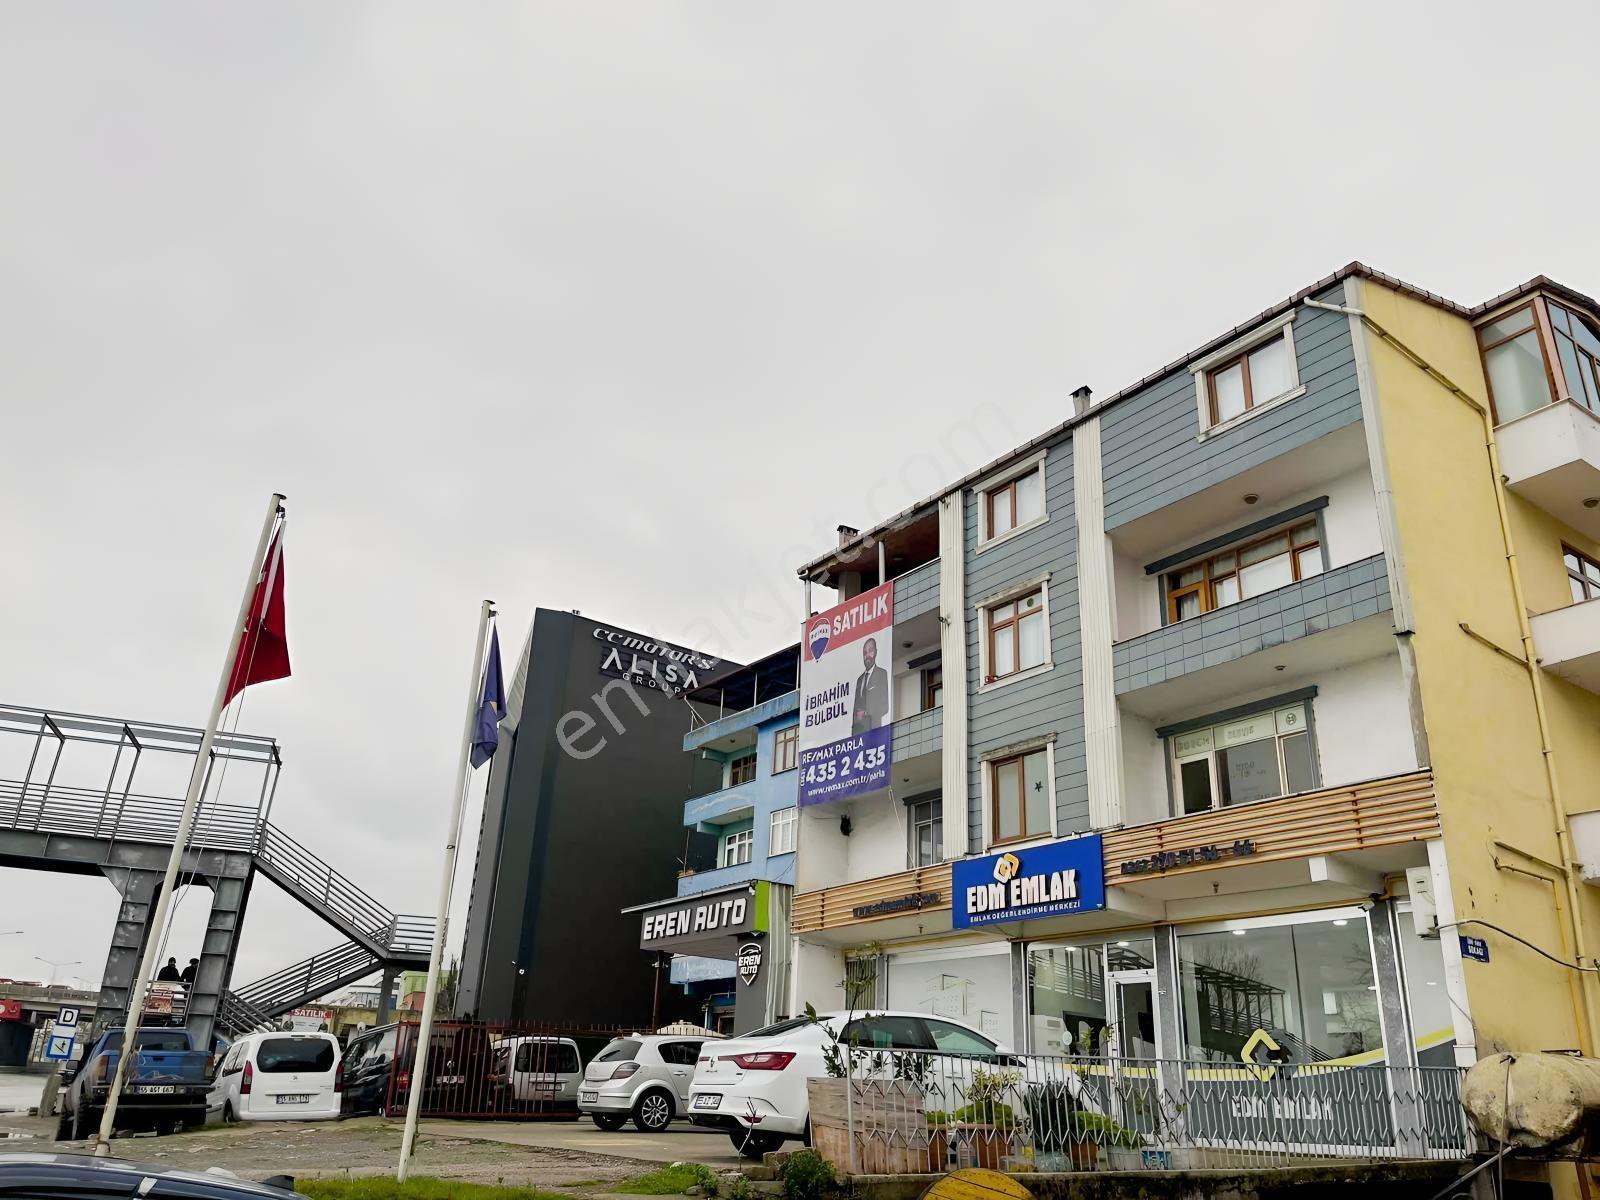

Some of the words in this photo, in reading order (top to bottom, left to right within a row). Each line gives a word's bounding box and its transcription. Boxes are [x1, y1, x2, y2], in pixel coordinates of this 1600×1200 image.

[833, 592, 889, 636] SATILIK
[622, 672, 681, 694] GROUP
[805, 682, 849, 711] İBRAHİM
[805, 701, 848, 728] BÜLBÜL
[802, 746, 834, 765] RE/MAX
[835, 737, 864, 756] PARLA
[806, 760, 837, 783] 435
[840, 756, 851, 777] 2
[853, 744, 886, 771] 435
[967, 882, 1006, 914] EDM
[1010, 868, 1077, 907] EMLAK
[643, 908, 692, 941] EREN
[694, 898, 747, 932] AUTO
[1049, 900, 1081, 912] MERKEZİ
[738, 954, 762, 967] EREN
[62, 1010, 74, 1023] D
